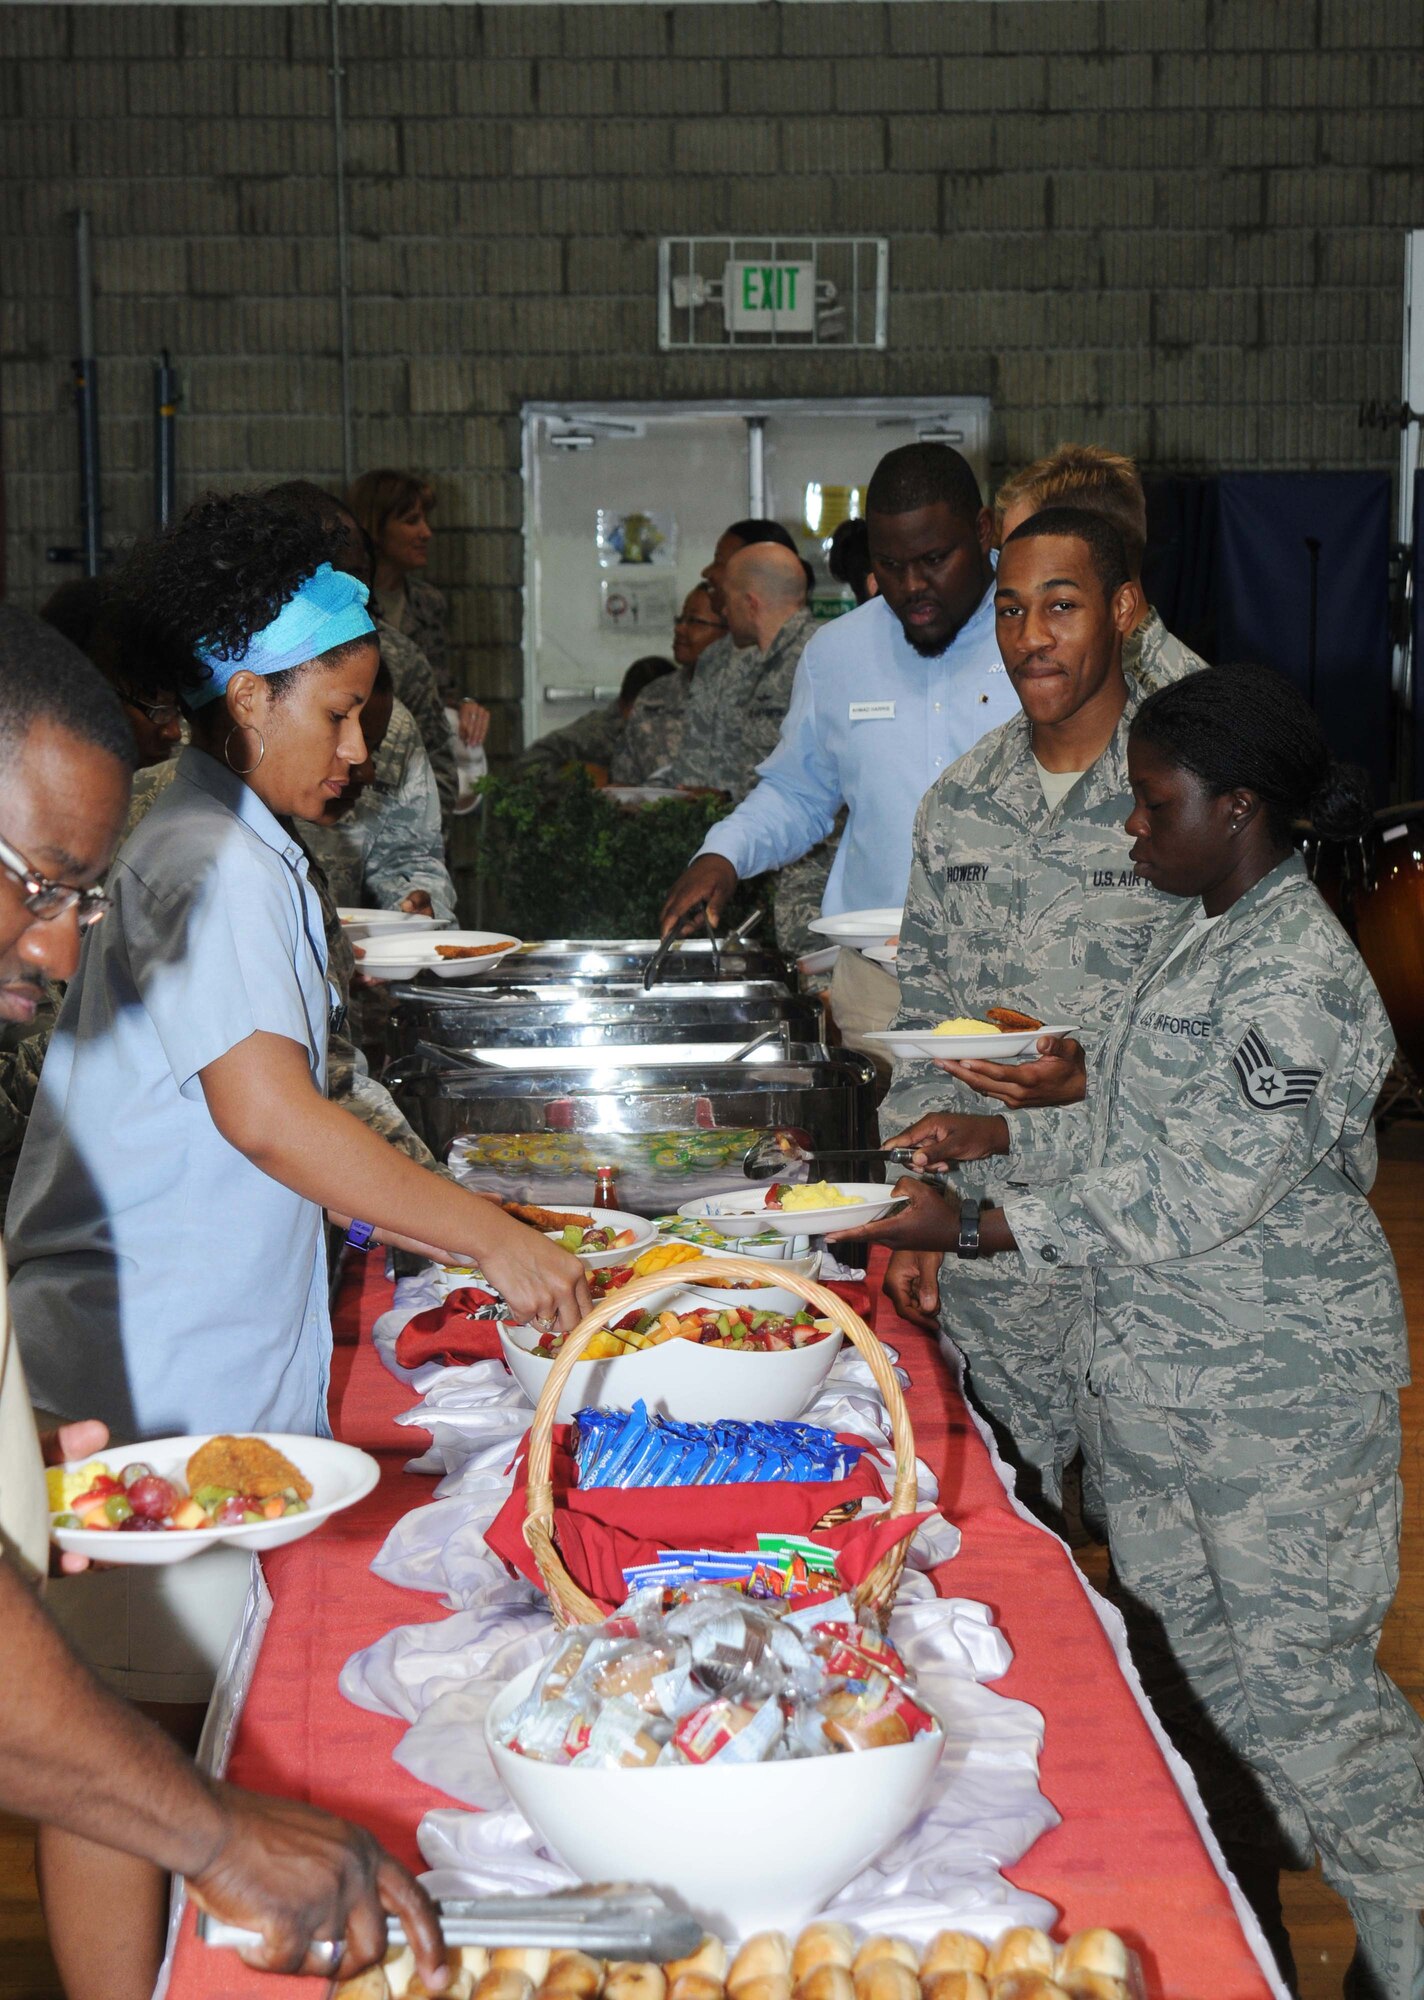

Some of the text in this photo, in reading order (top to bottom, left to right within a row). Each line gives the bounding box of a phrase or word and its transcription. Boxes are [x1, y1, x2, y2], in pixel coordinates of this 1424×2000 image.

[742, 266, 799, 310] EXIT
[946, 865, 989, 883] HOWERY
[1093, 870, 1115, 887] U.S.
[1117, 870, 1141, 887] AIR
[1162, 1015, 1211, 1037] FORCE
